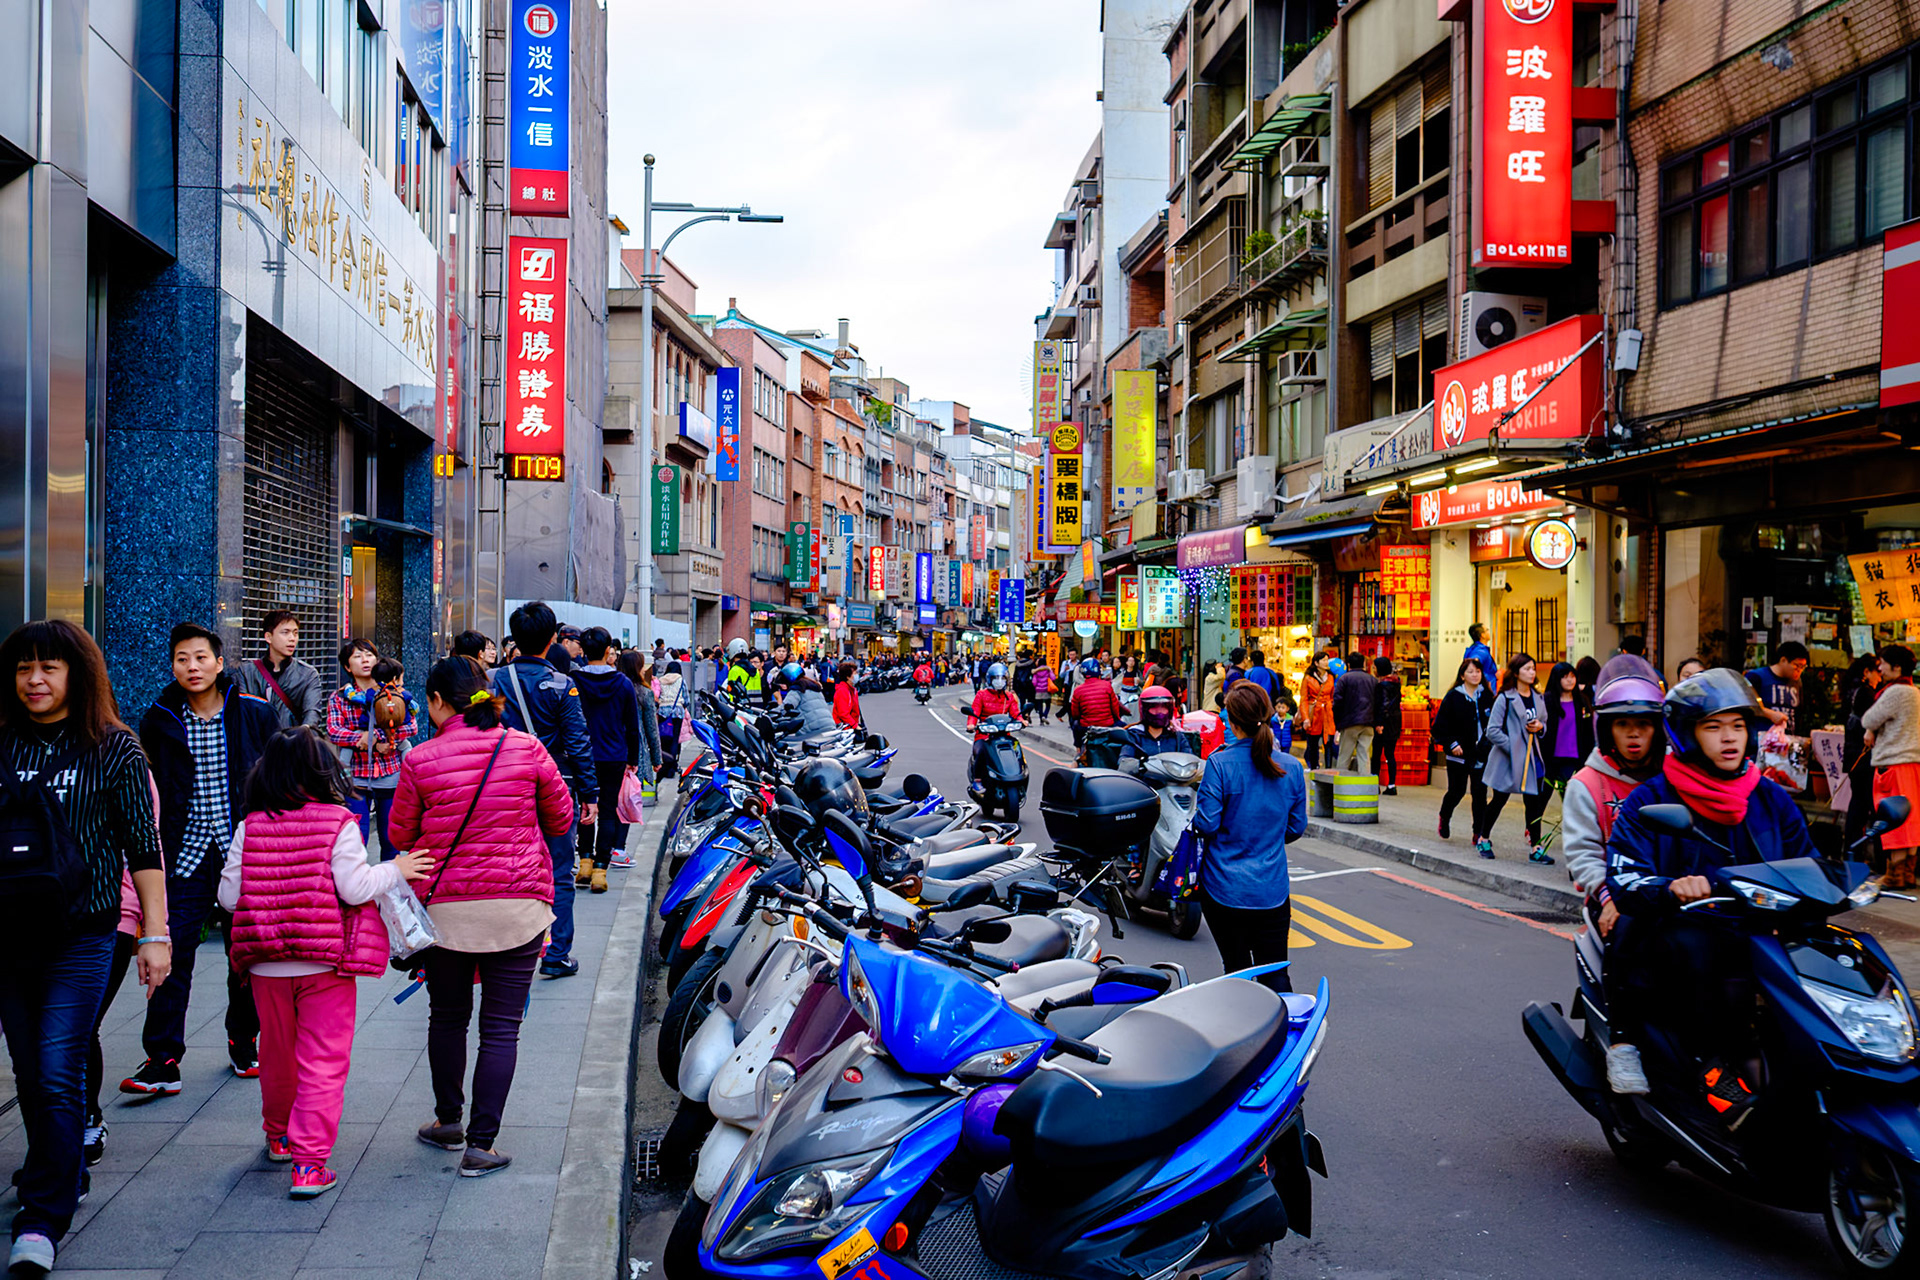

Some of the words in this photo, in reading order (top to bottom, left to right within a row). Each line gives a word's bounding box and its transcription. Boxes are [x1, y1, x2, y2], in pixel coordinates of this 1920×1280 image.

[526, 45, 553, 148] 淡水一信
[1506, 45, 1552, 182] 波羅旺
[522, 186, 556, 201] 總社
[1487, 243, 1567, 258] BOLOKING
[516, 291, 554, 437] 福勝證券
[1472, 368, 1528, 415] 波羅旺
[1056, 458, 1078, 525] 黑橋牌
[661, 485, 671, 548] 淡水信用合作社
[1382, 558, 1431, 575] 正宗滬尾
[1382, 576, 1431, 593] 手工現做
[1772, 684, 1799, 707] IT'S
